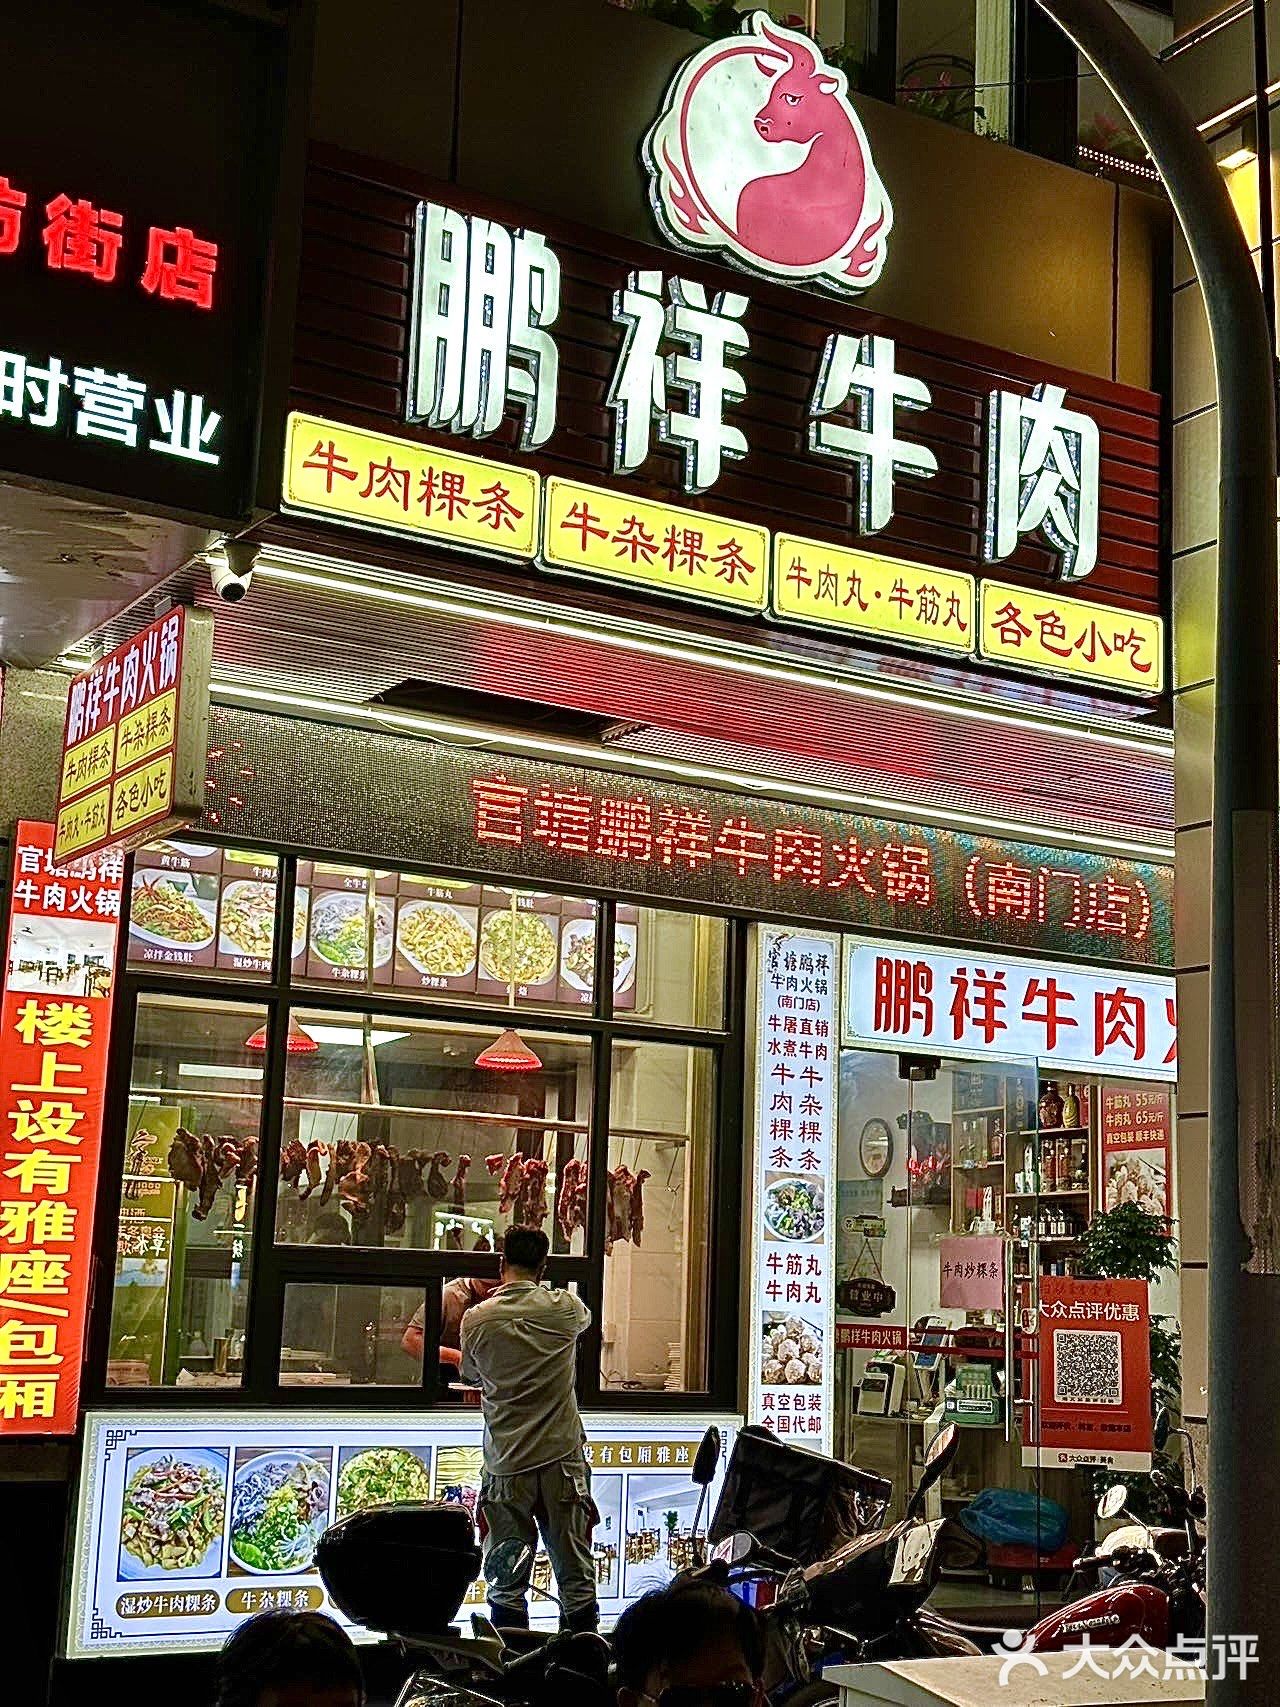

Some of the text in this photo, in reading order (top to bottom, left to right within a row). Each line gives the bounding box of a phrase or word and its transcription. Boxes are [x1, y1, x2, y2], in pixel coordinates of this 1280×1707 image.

[405, 200, 1100, 582] 鹏祥牛肉
[0, 351, 221, 466] 时营业
[302, 440, 525, 533] 牛肉粿条
[560, 501, 757, 584] 牛杂粿条
[990, 600, 1154, 674] 各色小吃
[67, 614, 179, 747] 鹏祥牛肉火锅
[120, 706, 171, 757] 牛杂粿条
[66, 741, 111, 788] 牛肉粿条
[115, 773, 167, 822] 各色小吃
[14, 879, 120, 917] 牛肉火锅
[771, 973, 829, 995] 牛肉火锅
[768, 1037, 829, 1061] 水煮牛肉
[1105, 1112, 1132, 1127] 牛肉丸
[766, 1252, 822, 1277] 牛筋丸
[943, 1261, 999, 1280] 牛肉炒粿条
[765, 1279, 822, 1304] 牛肉丸
[761, 1392, 823, 1413] 真空包装
[761, 1415, 823, 1435] 全国代邮
[120, 1591, 217, 1616] 湿炒牛肉粿条
[241, 1588, 310, 1610] 牛杂粿条
